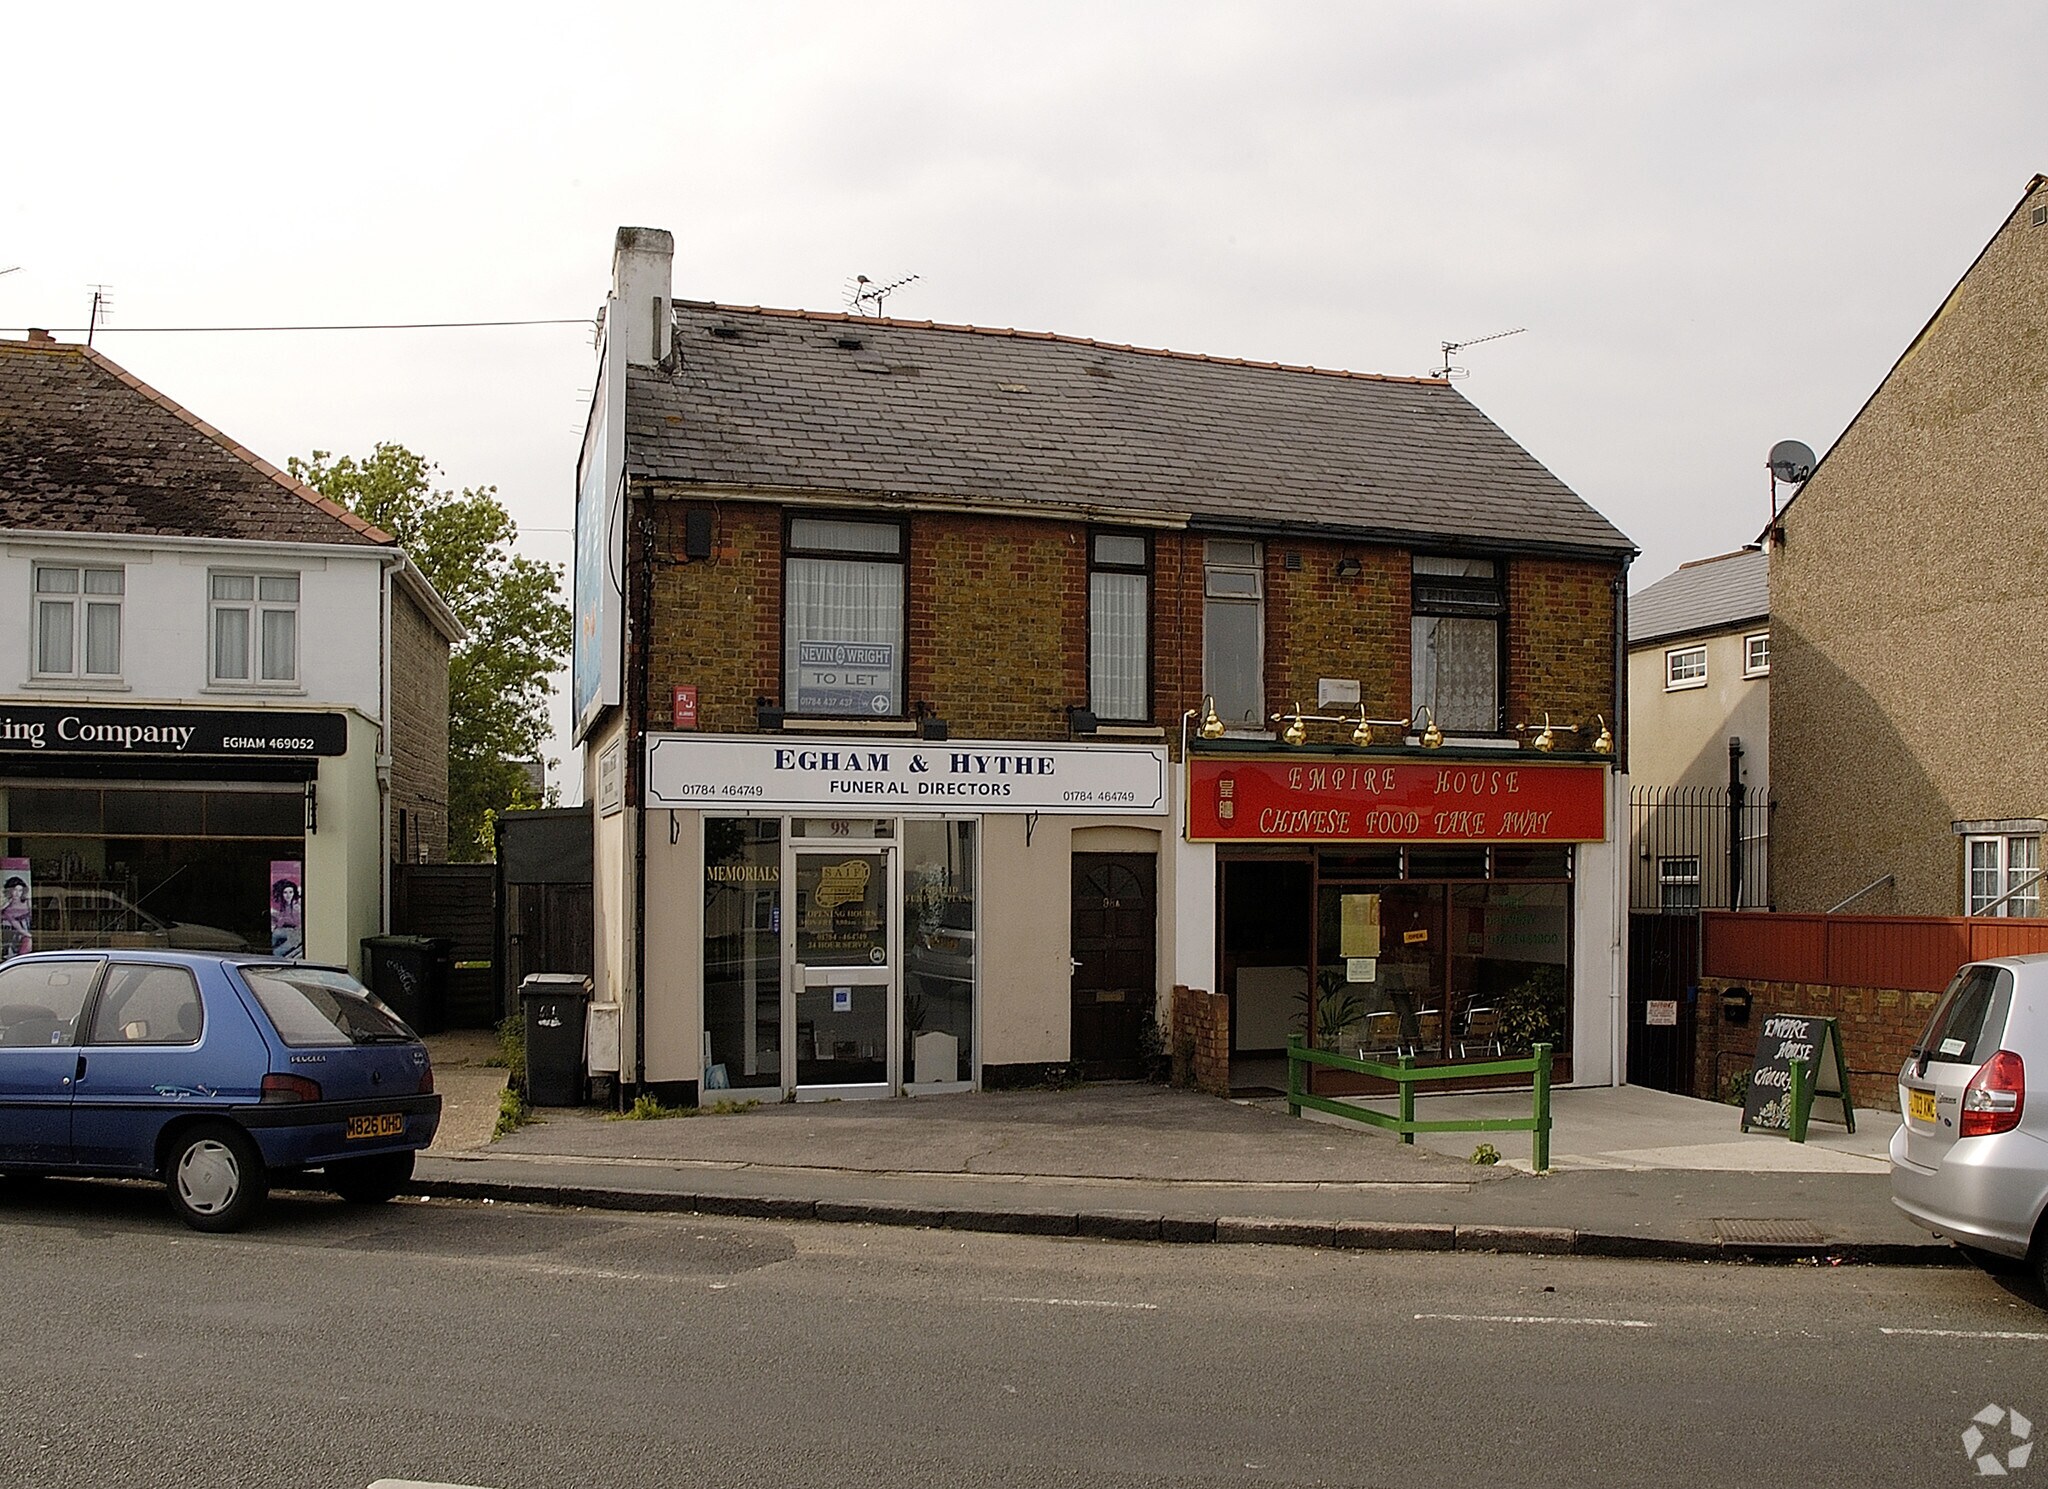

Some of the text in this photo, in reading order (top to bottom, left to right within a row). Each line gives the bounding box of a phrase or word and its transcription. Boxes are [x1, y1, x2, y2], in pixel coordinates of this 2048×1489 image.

[801, 647, 834, 663] NEVIN
[848, 649, 890, 664] WRIGHT
[813, 672, 878, 686] TO LET
[57, 716, 197, 750] Company
[222, 736, 315, 750] EGHAM 469052
[774, 749, 1055, 775] EGHAM & HYTHE
[829, 780, 1011, 796] FUNERAL DIRECTORS
[1288, 767, 1520, 795] EMPIRE HOUSE
[682, 784, 763, 797] 01784 464749
[1063, 790, 1135, 802] 01784 464749
[830, 821, 850, 836] 98
[1259, 807, 1552, 837] CHINESE FOOD TAKE AWAY
[706, 866, 779, 882] MEMORIALS
[1764, 1018, 1810, 1039] EMPIRE
[1773, 1040, 1814, 1060] HOUSE
